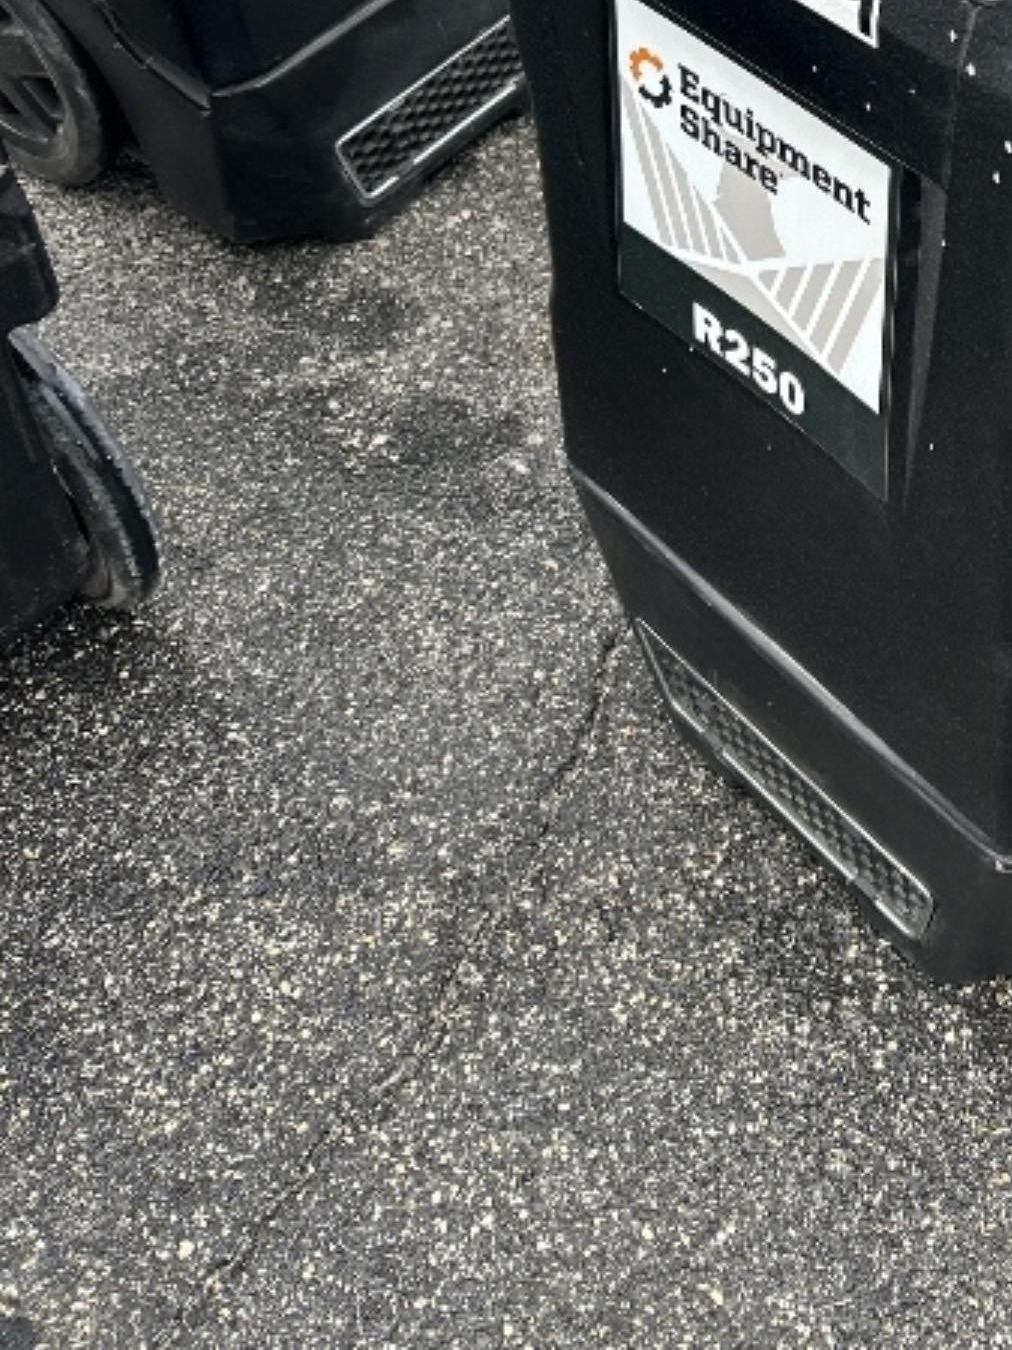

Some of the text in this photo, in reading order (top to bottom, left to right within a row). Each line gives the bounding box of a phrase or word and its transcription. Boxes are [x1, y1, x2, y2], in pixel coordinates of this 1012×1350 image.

[677, 62, 871, 225] Equipment
[679, 103, 779, 196] Share
[692, 301, 806, 416] R250
